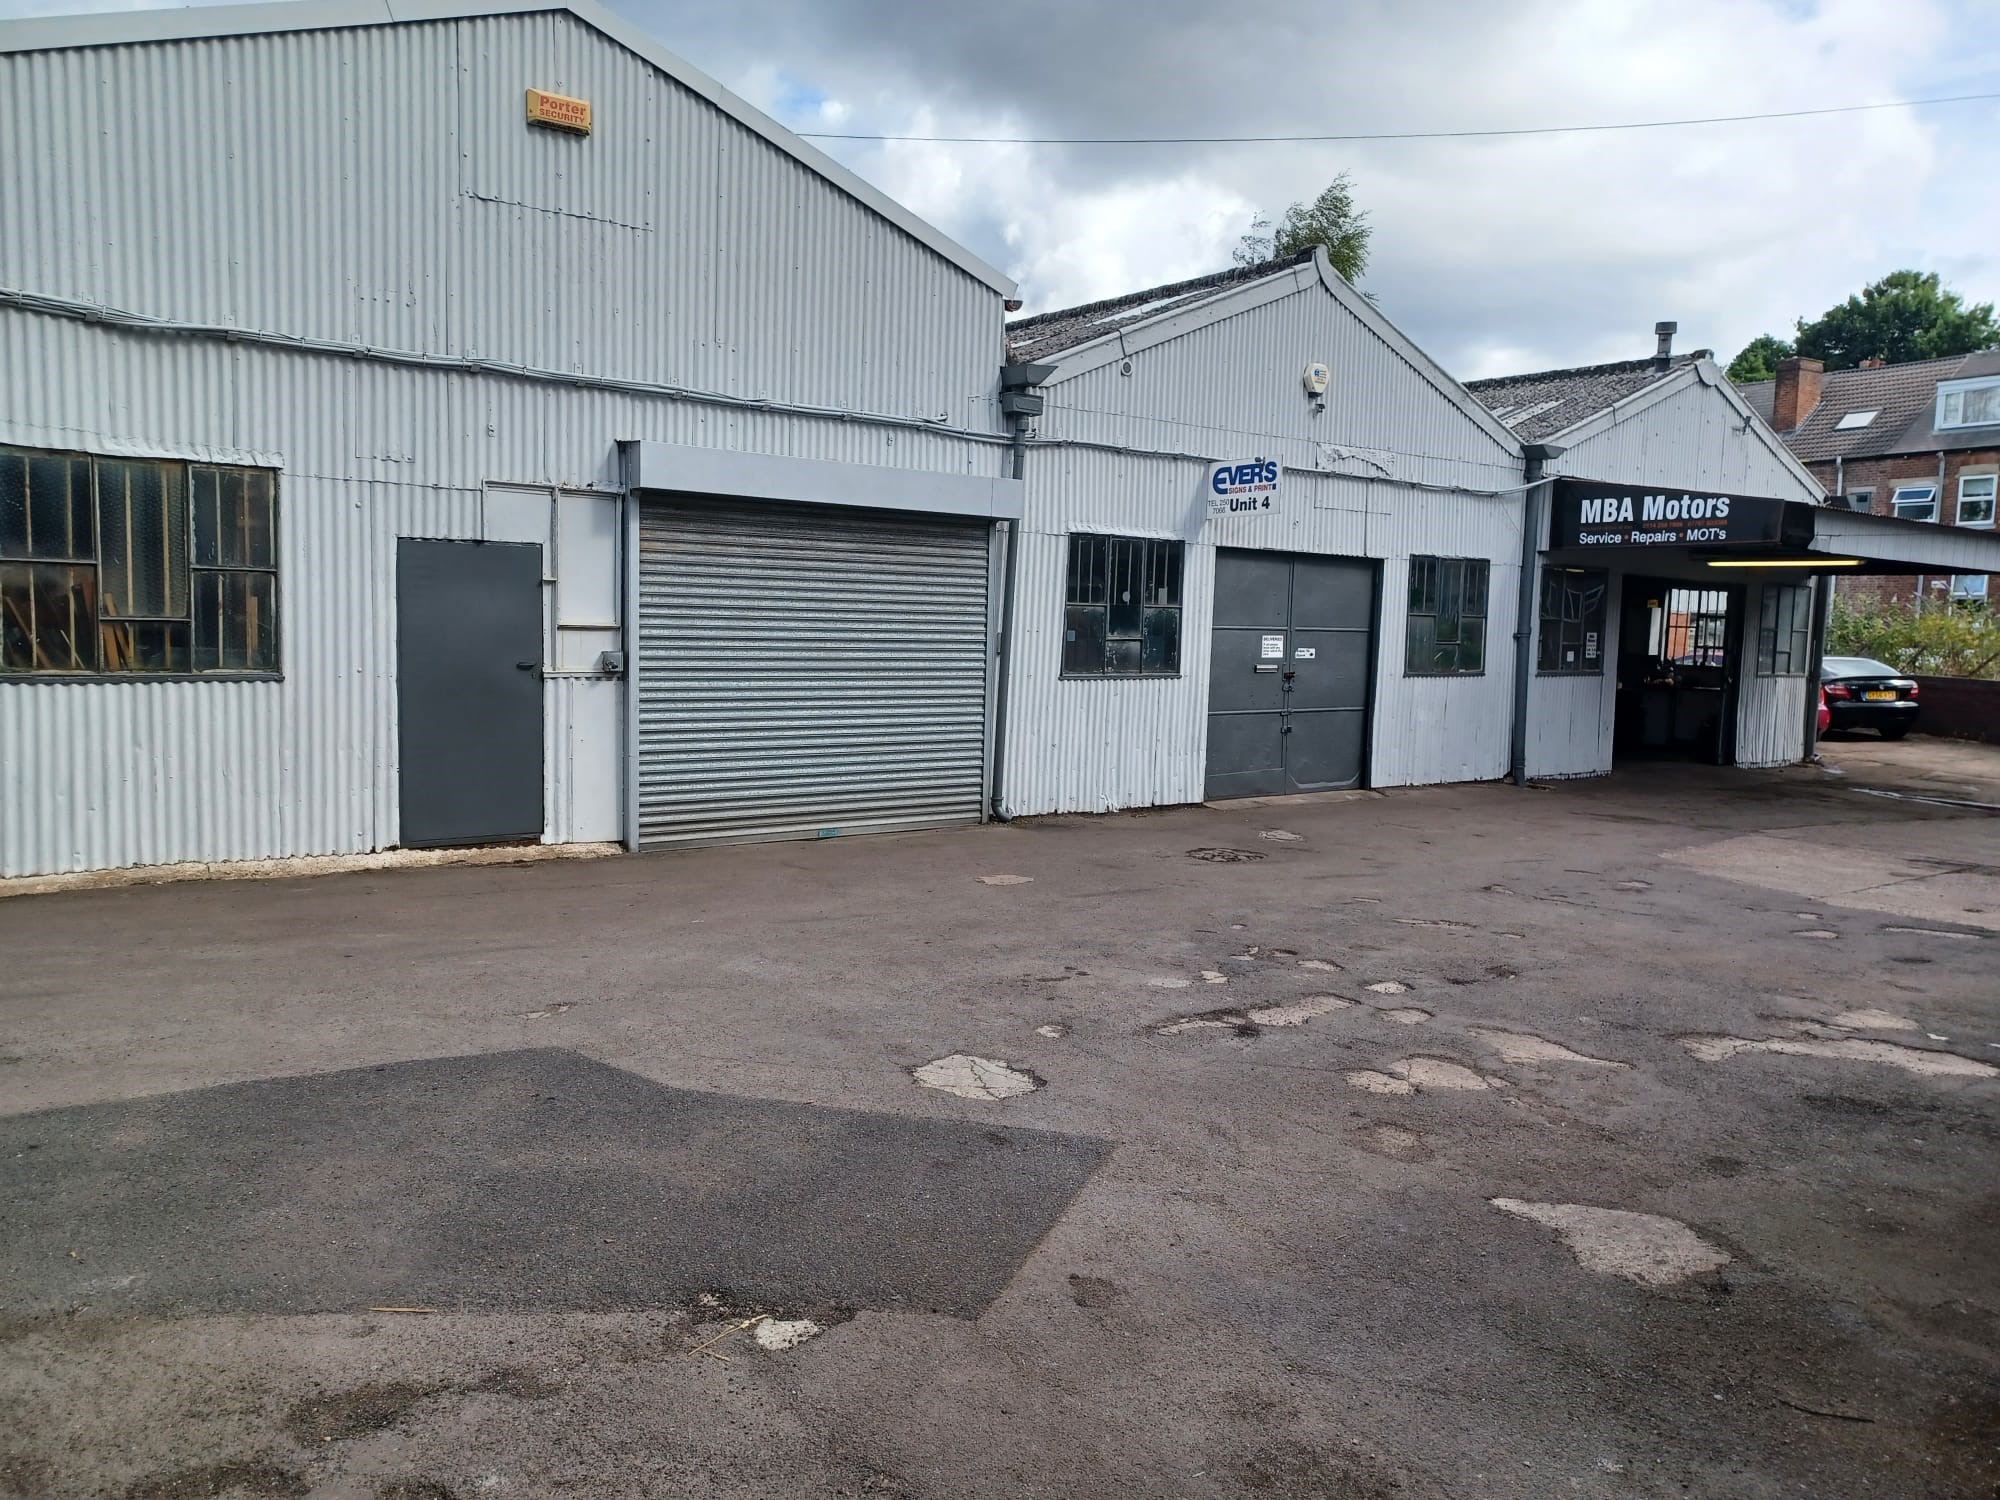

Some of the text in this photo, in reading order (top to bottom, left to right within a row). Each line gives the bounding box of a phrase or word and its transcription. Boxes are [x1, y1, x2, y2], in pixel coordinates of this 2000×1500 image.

[540, 95, 586, 116] Porter
[539, 108, 585, 124] SECURITY
[1228, 486, 1247, 495] SIGNS
[1254, 484, 1272, 492] PRINT
[1229, 495, 1271, 512] Unit 4
[1580, 494, 1730, 524] MBA Motors
[1579, 527, 1727, 545] Service Repairs MOT's
